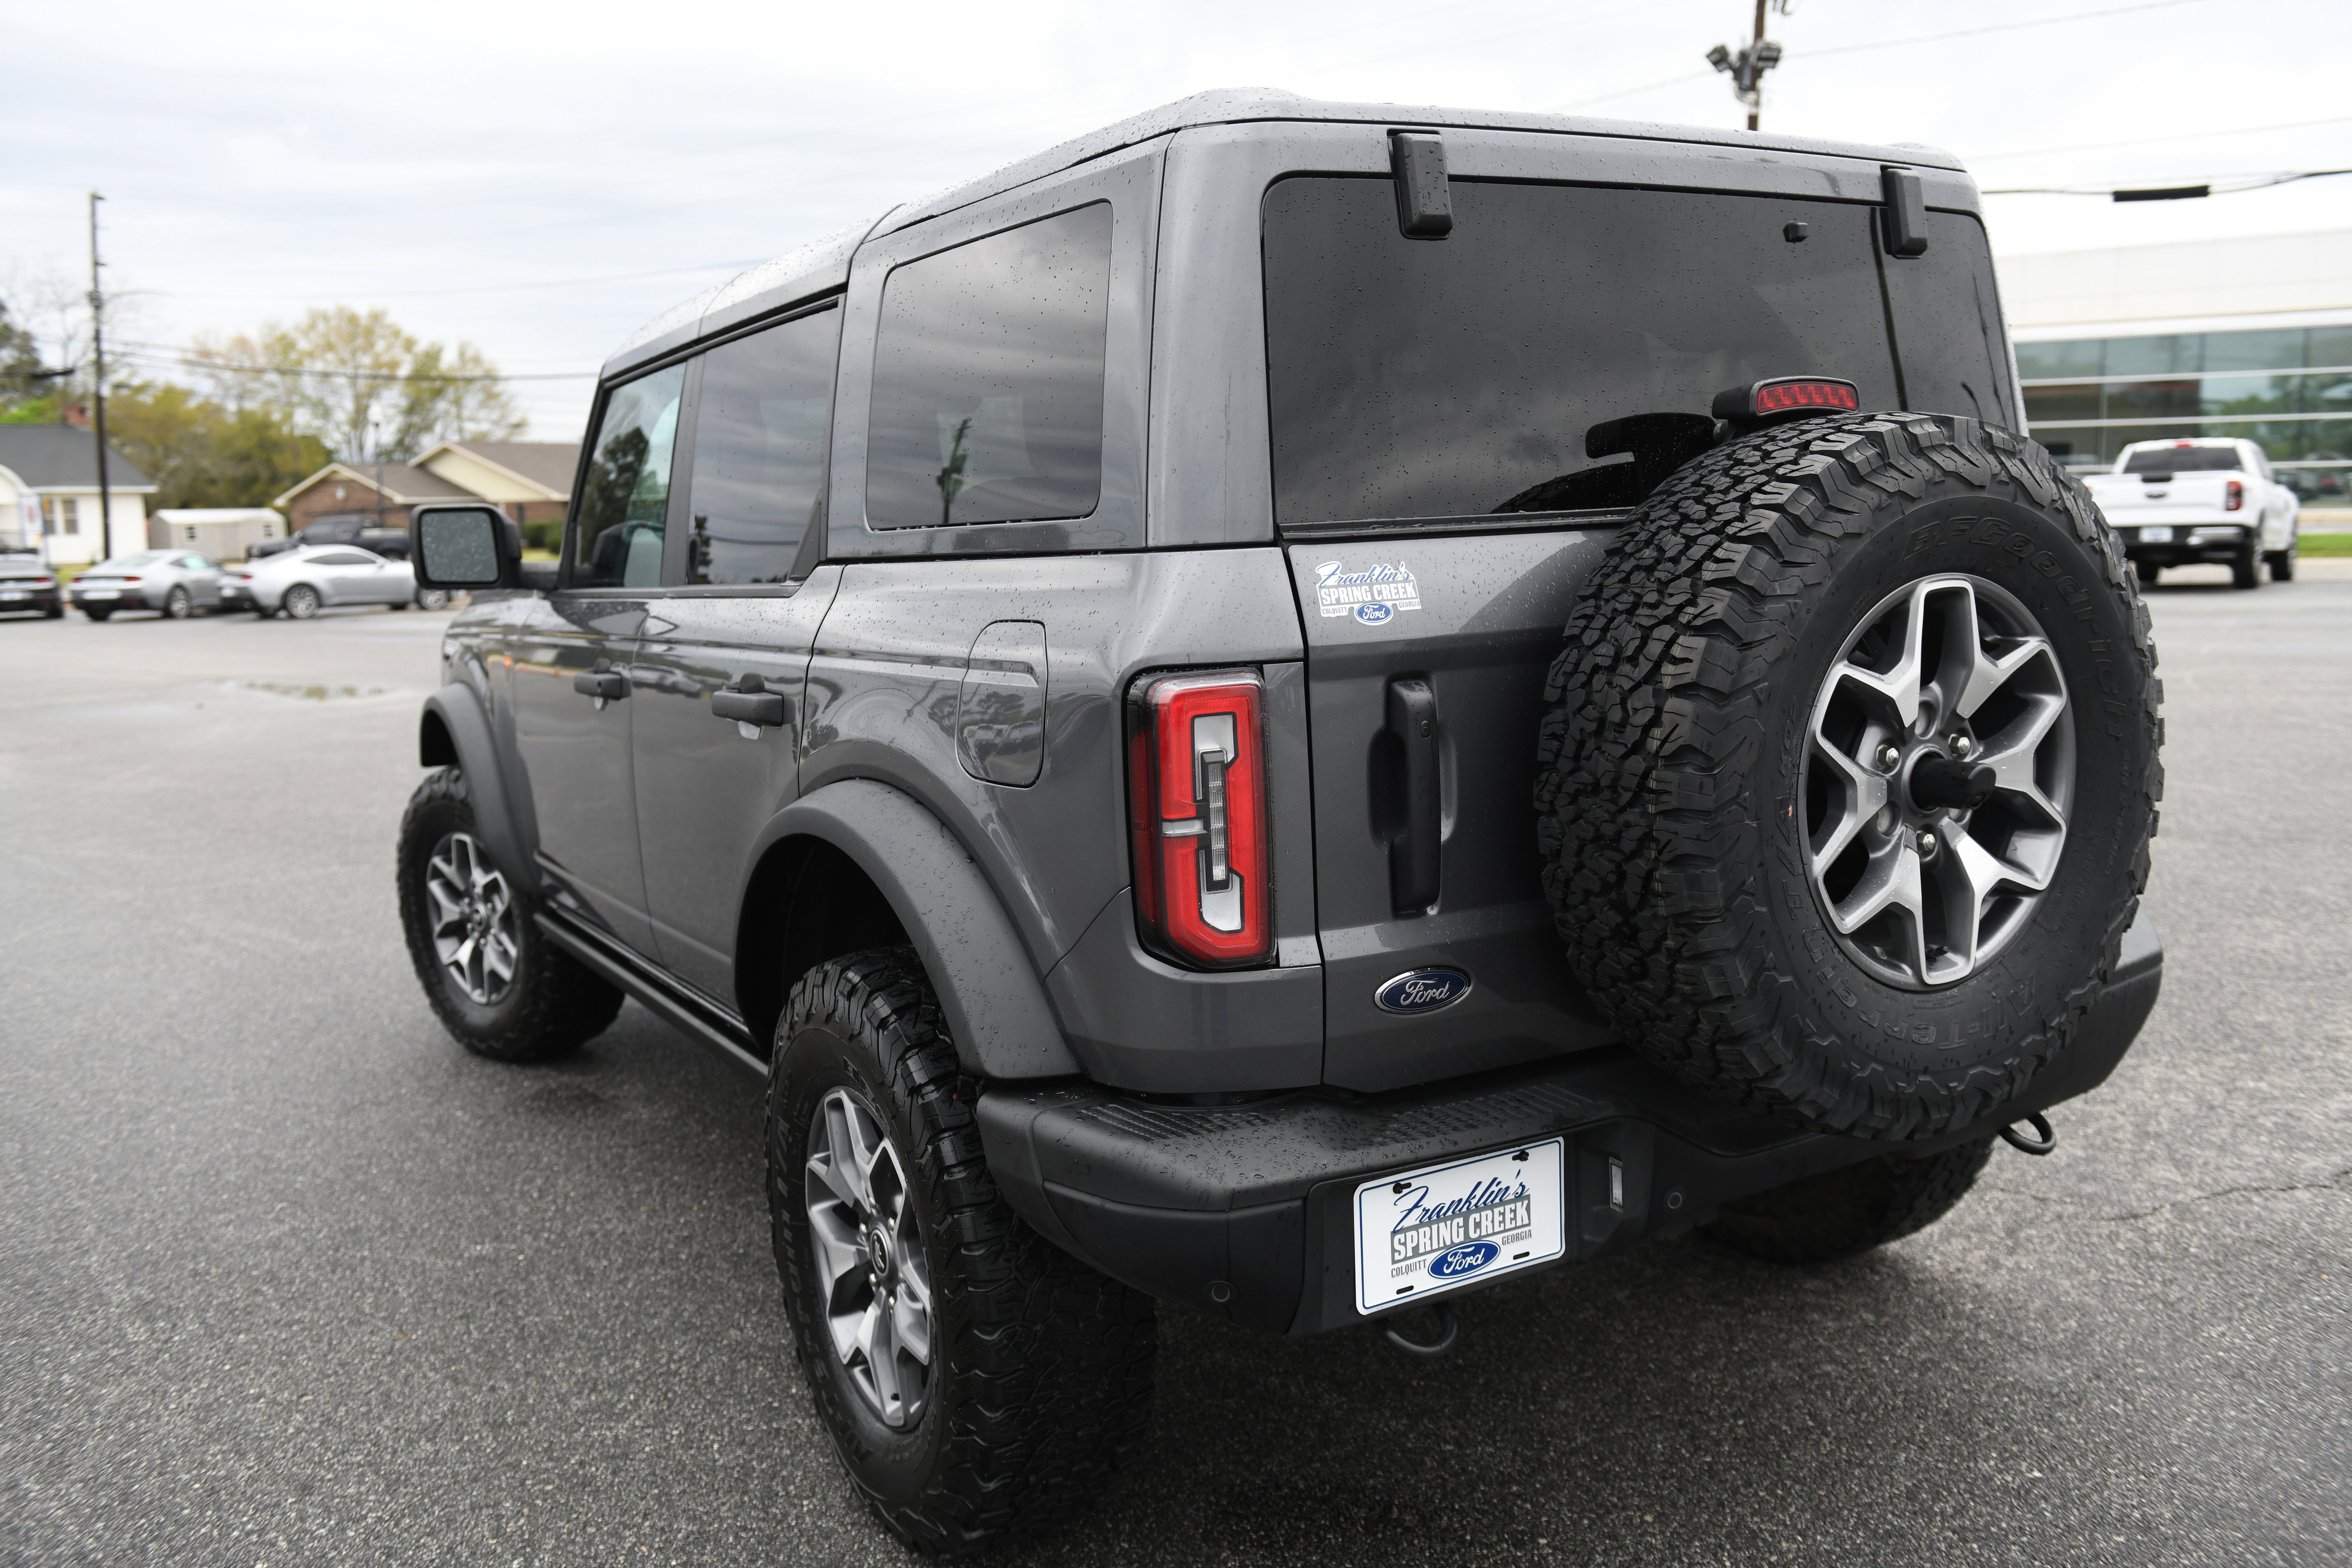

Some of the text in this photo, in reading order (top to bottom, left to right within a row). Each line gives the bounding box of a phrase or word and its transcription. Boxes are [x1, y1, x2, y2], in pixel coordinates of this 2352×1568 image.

[1316, 562, 1412, 588] Franklin's
[1321, 582, 1417, 605] SPRING CREEK
[1322, 607, 1347, 615] COLQUITT
[1363, 604, 1386, 619] Ford
[1902, 516, 2127, 737] BFGoodrich
[1400, 978, 1450, 1006] Ford
[1392, 1169, 1530, 1234] Franklin's
[1393, 1199, 1530, 1261] SPRING CREEK
[1501, 1229, 1532, 1245] GEORGIA
[1391, 1258, 1427, 1278] COLQUITT
[1443, 1246, 1485, 1274] Ford
